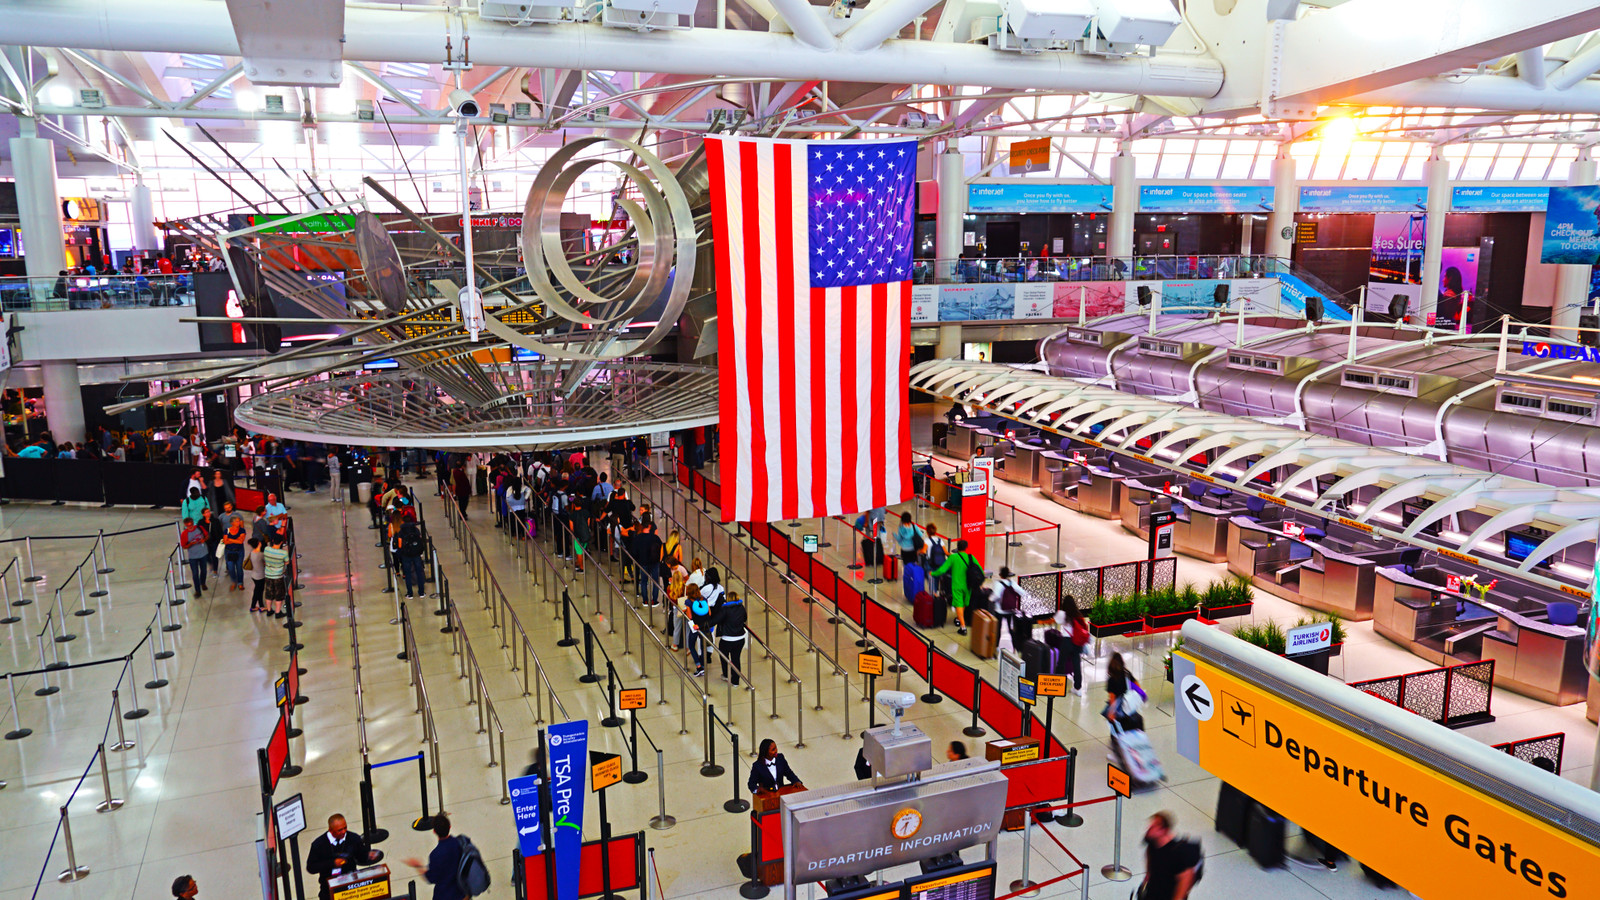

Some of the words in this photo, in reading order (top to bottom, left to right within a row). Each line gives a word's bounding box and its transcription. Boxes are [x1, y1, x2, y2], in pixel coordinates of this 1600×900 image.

[978, 188, 1004, 196] interjet
[1149, 188, 1174, 196] interjet
[1308, 189, 1332, 197] interjet
[1557, 222, 1574, 230] 4PM
[1561, 242, 1571, 250] TO
[1572, 242, 1599, 250] CHECK
[1293, 631, 1320, 641] TURKISH
[1292, 637, 1319, 646] AIRLINES
[555, 754, 571, 787] TSA
[556, 788, 573, 816] Pre
[516, 804, 537, 814] Enter
[1265, 720, 1430, 827] Departure
[1444, 813, 1568, 898] Gates
[517, 811, 537, 821] Here
[808, 845, 894, 871] DEPARTURE
[900, 822, 992, 852] INFORMATION
[347, 879, 374, 890] SECURITY
[369, 884, 381, 892] your
[919, 881, 948, 890] Departures
[371, 888, 385, 896] ready
